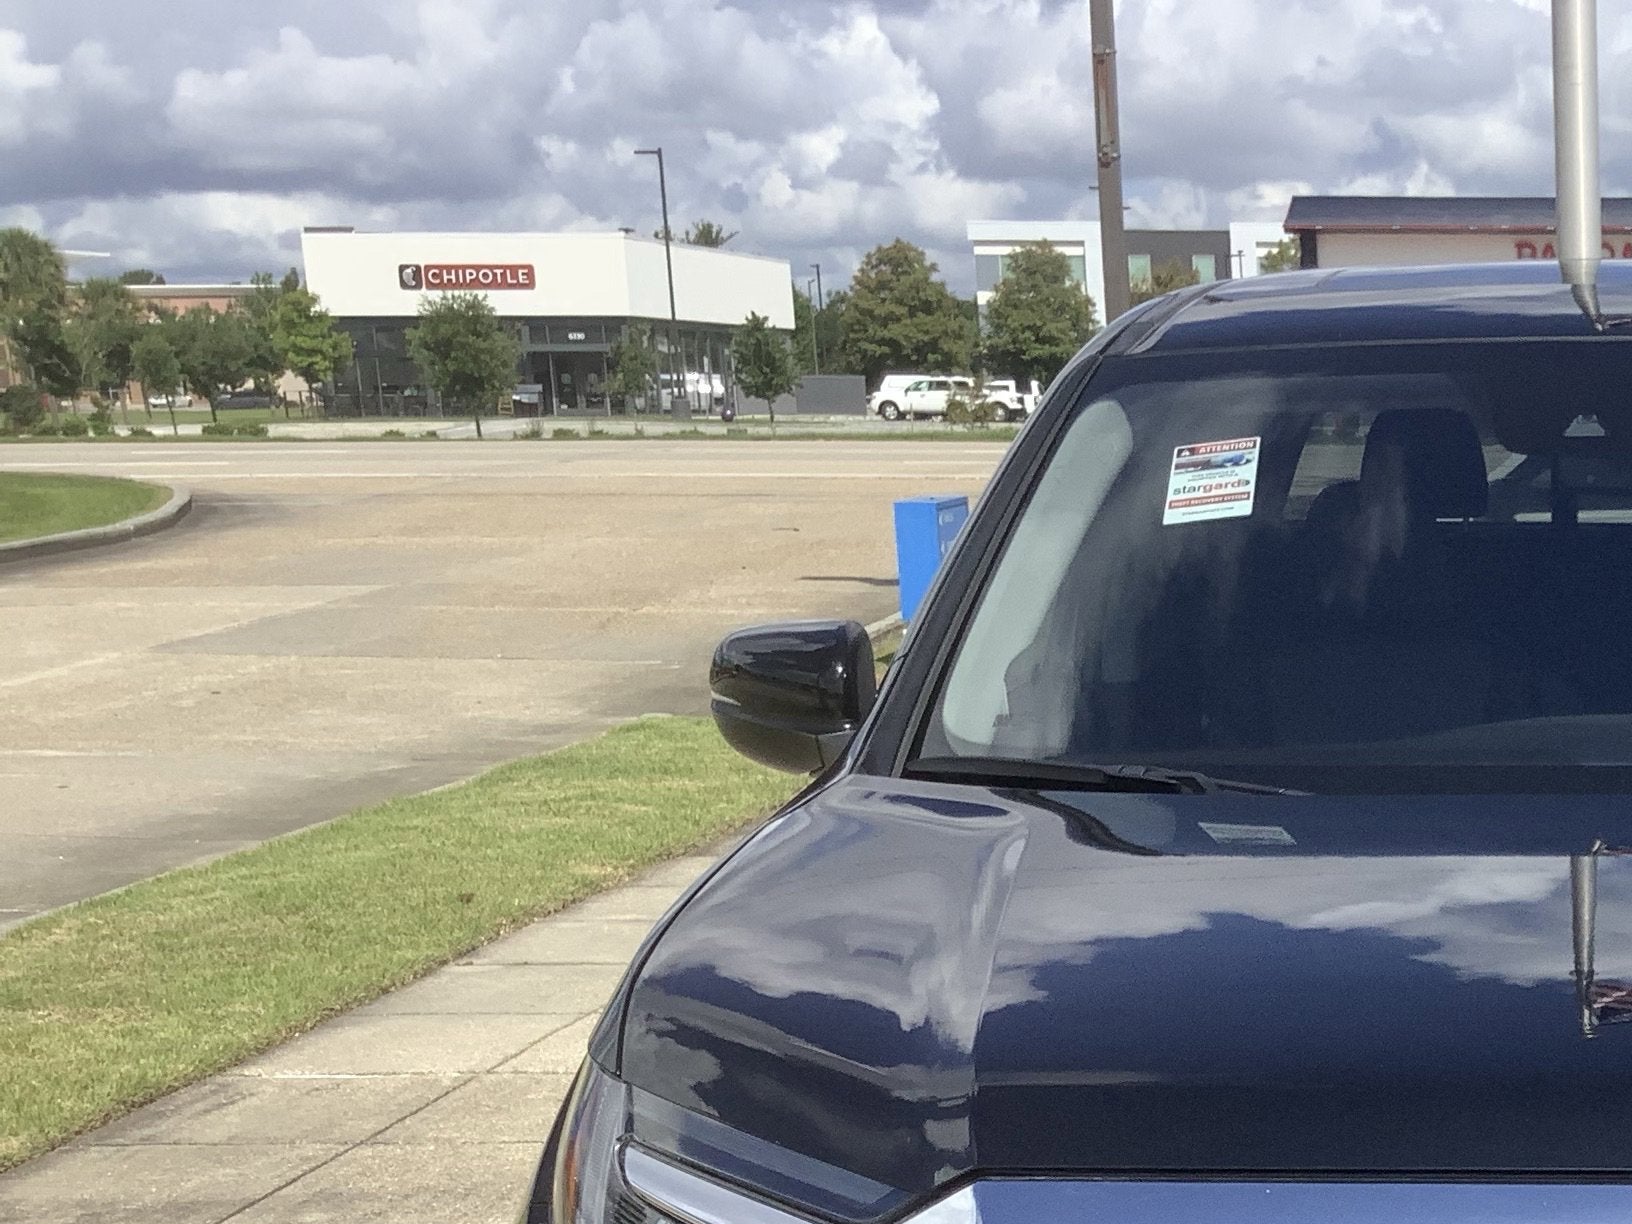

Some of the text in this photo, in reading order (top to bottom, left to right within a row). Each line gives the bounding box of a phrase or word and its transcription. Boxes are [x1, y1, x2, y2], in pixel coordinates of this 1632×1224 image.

[427, 268, 530, 284] CHIPOTLE
[1199, 441, 1254, 454] ATTENTION
[1172, 479, 1241, 496] stargard
